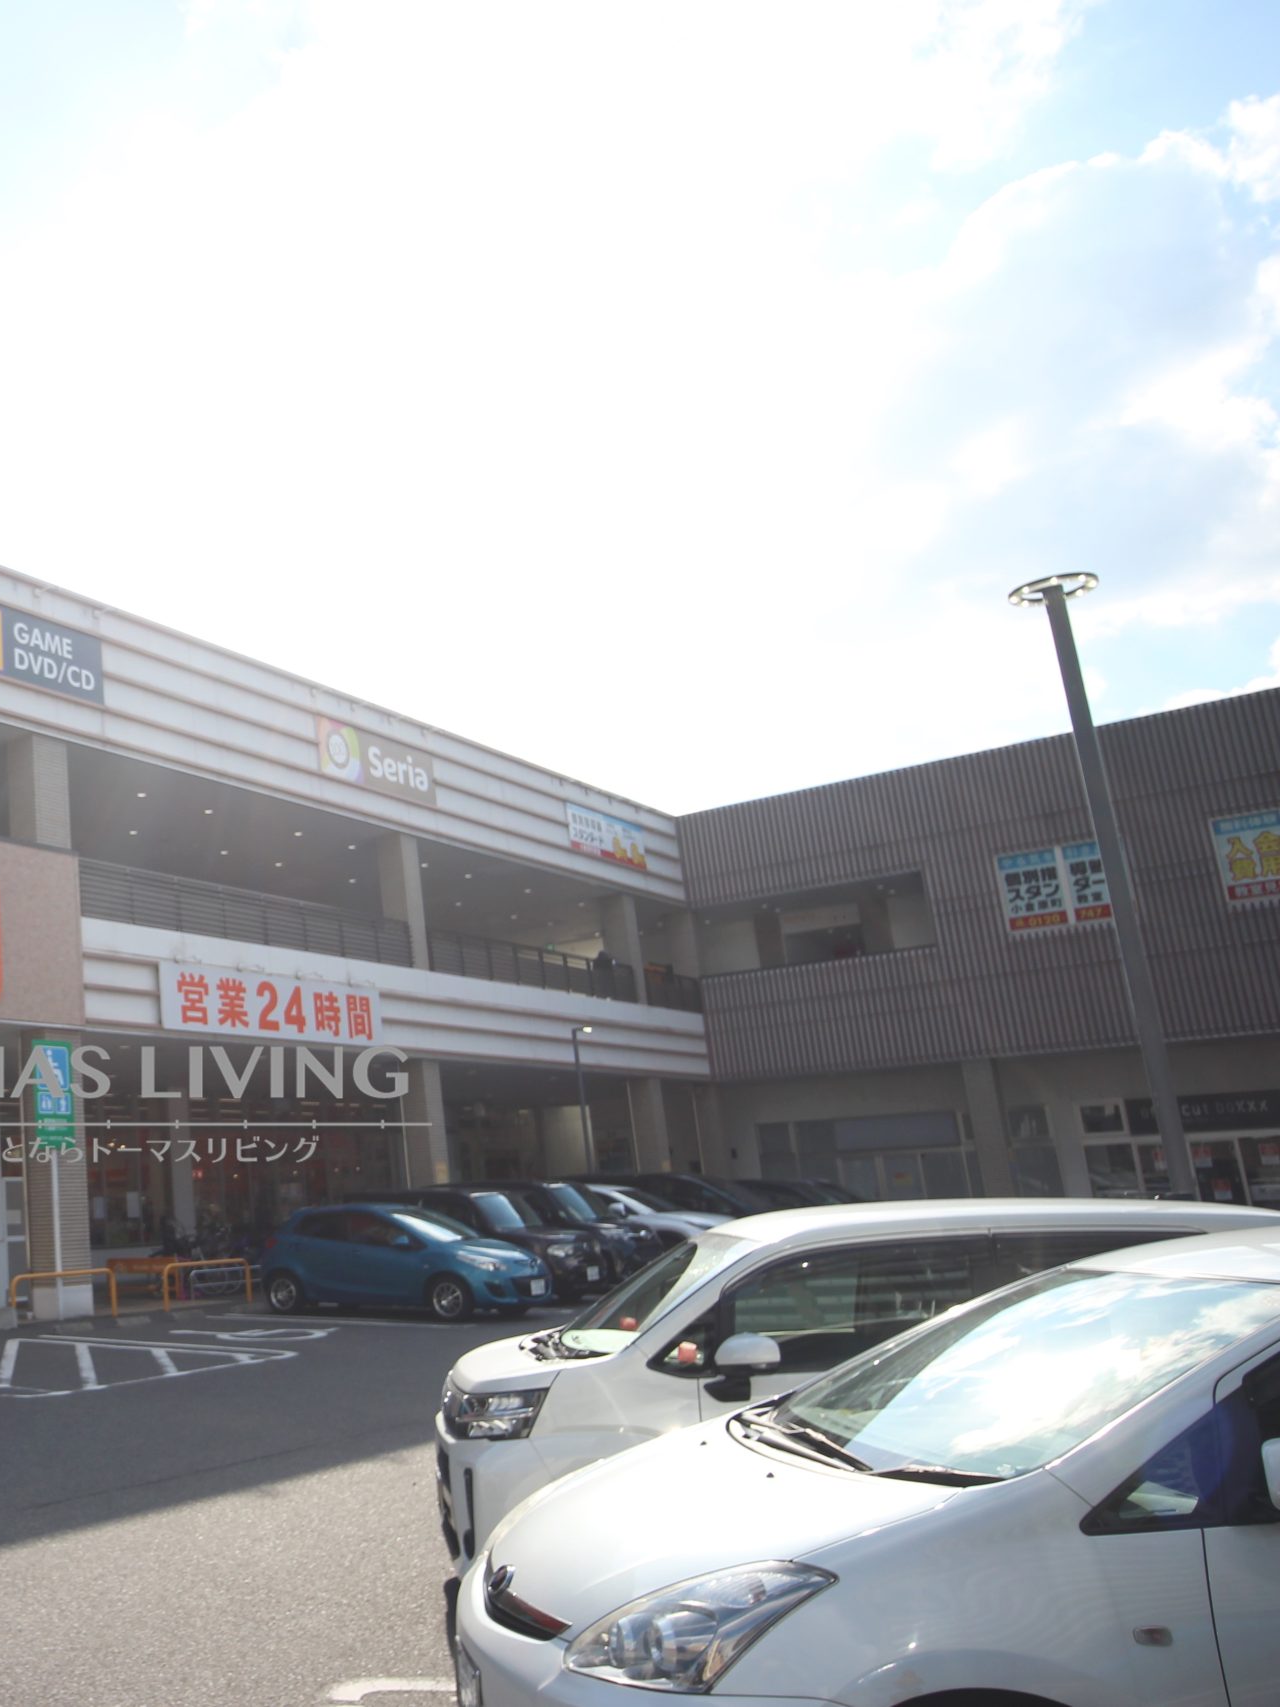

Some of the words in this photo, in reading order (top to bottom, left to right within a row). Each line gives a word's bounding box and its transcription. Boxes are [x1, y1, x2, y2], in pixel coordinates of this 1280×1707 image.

[13, 622, 73, 660] GAME
[14, 647, 95, 691] DVD/CD
[368, 746, 429, 792] Seria
[176, 971, 373, 1041] 営業24時間
